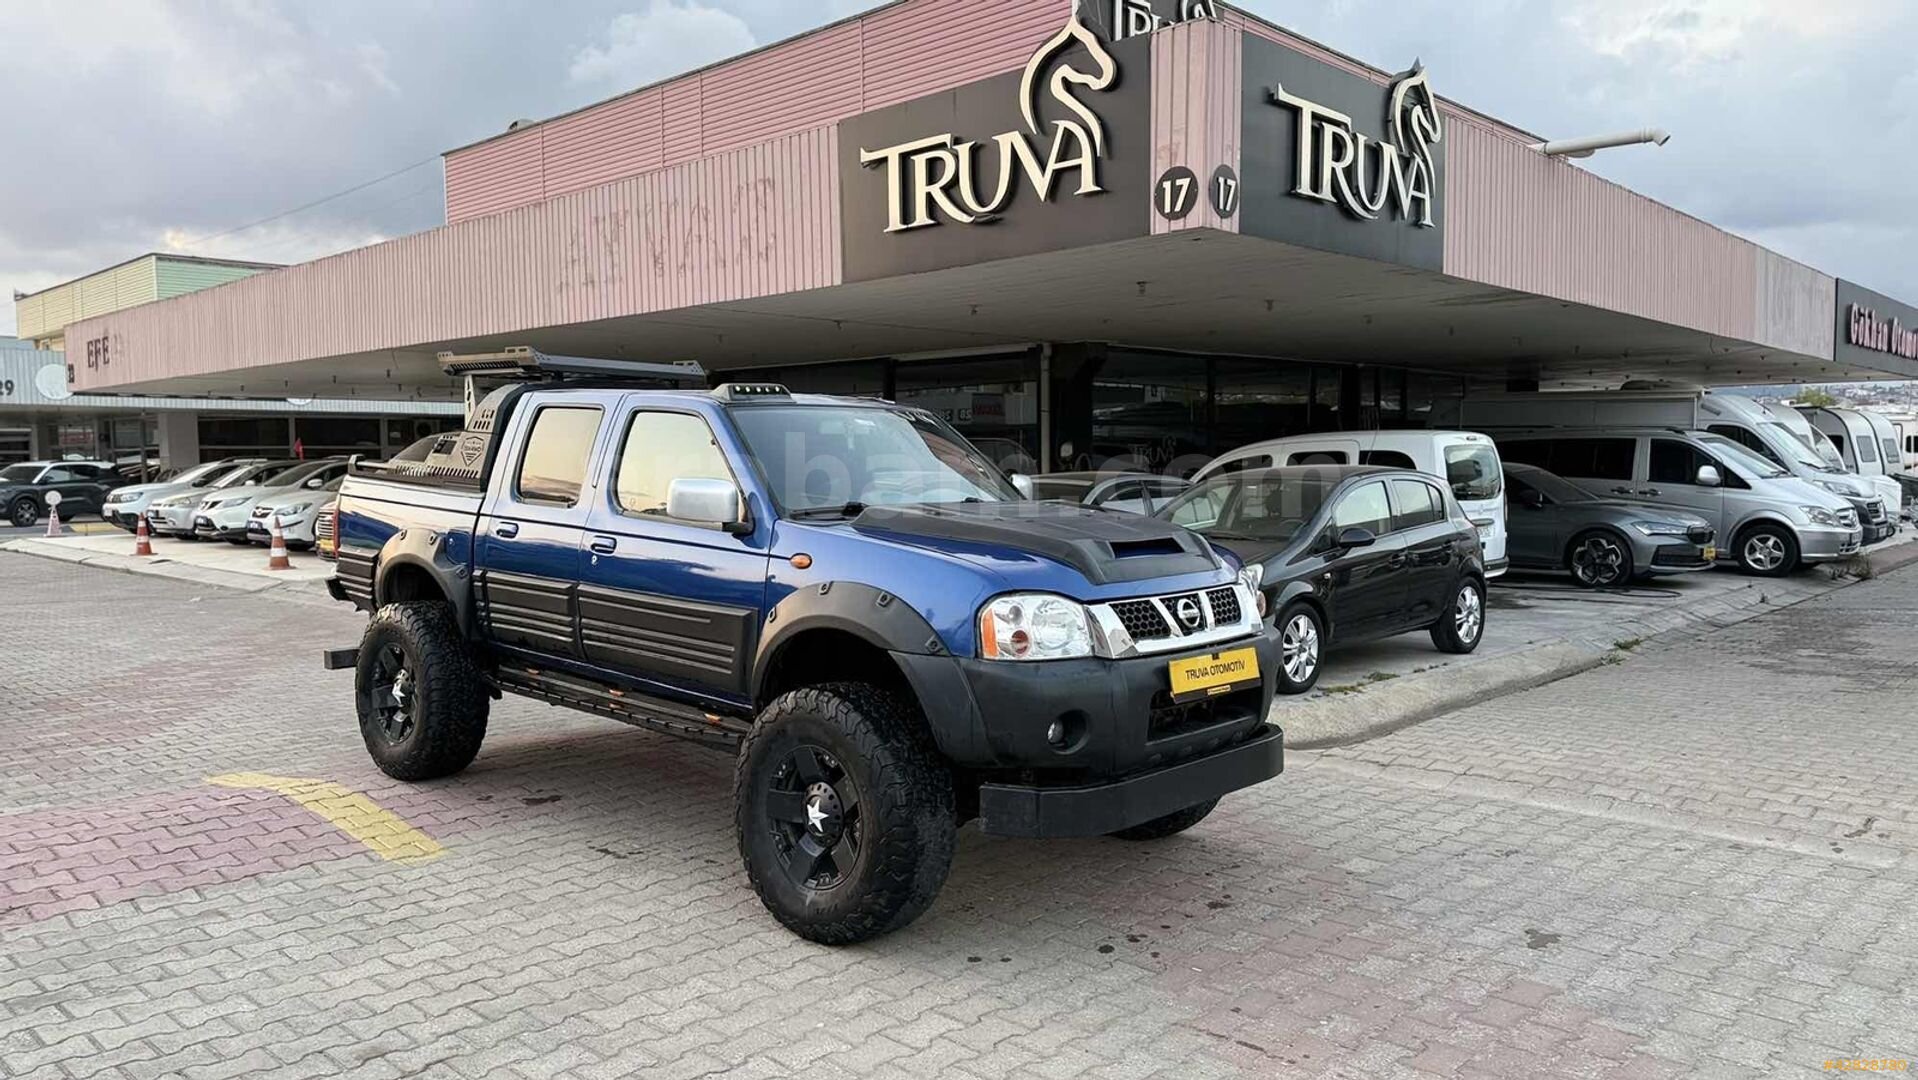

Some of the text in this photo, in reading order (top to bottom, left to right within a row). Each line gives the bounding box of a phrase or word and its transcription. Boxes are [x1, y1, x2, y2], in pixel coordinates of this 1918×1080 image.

[1273, 83, 1435, 228] TRUVA
[860, 120, 1104, 233] TRUVA
[1216, 176, 1237, 212] 17
[1162, 177, 1192, 213] 17
[1185, 667, 1209, 680] TRUVA
